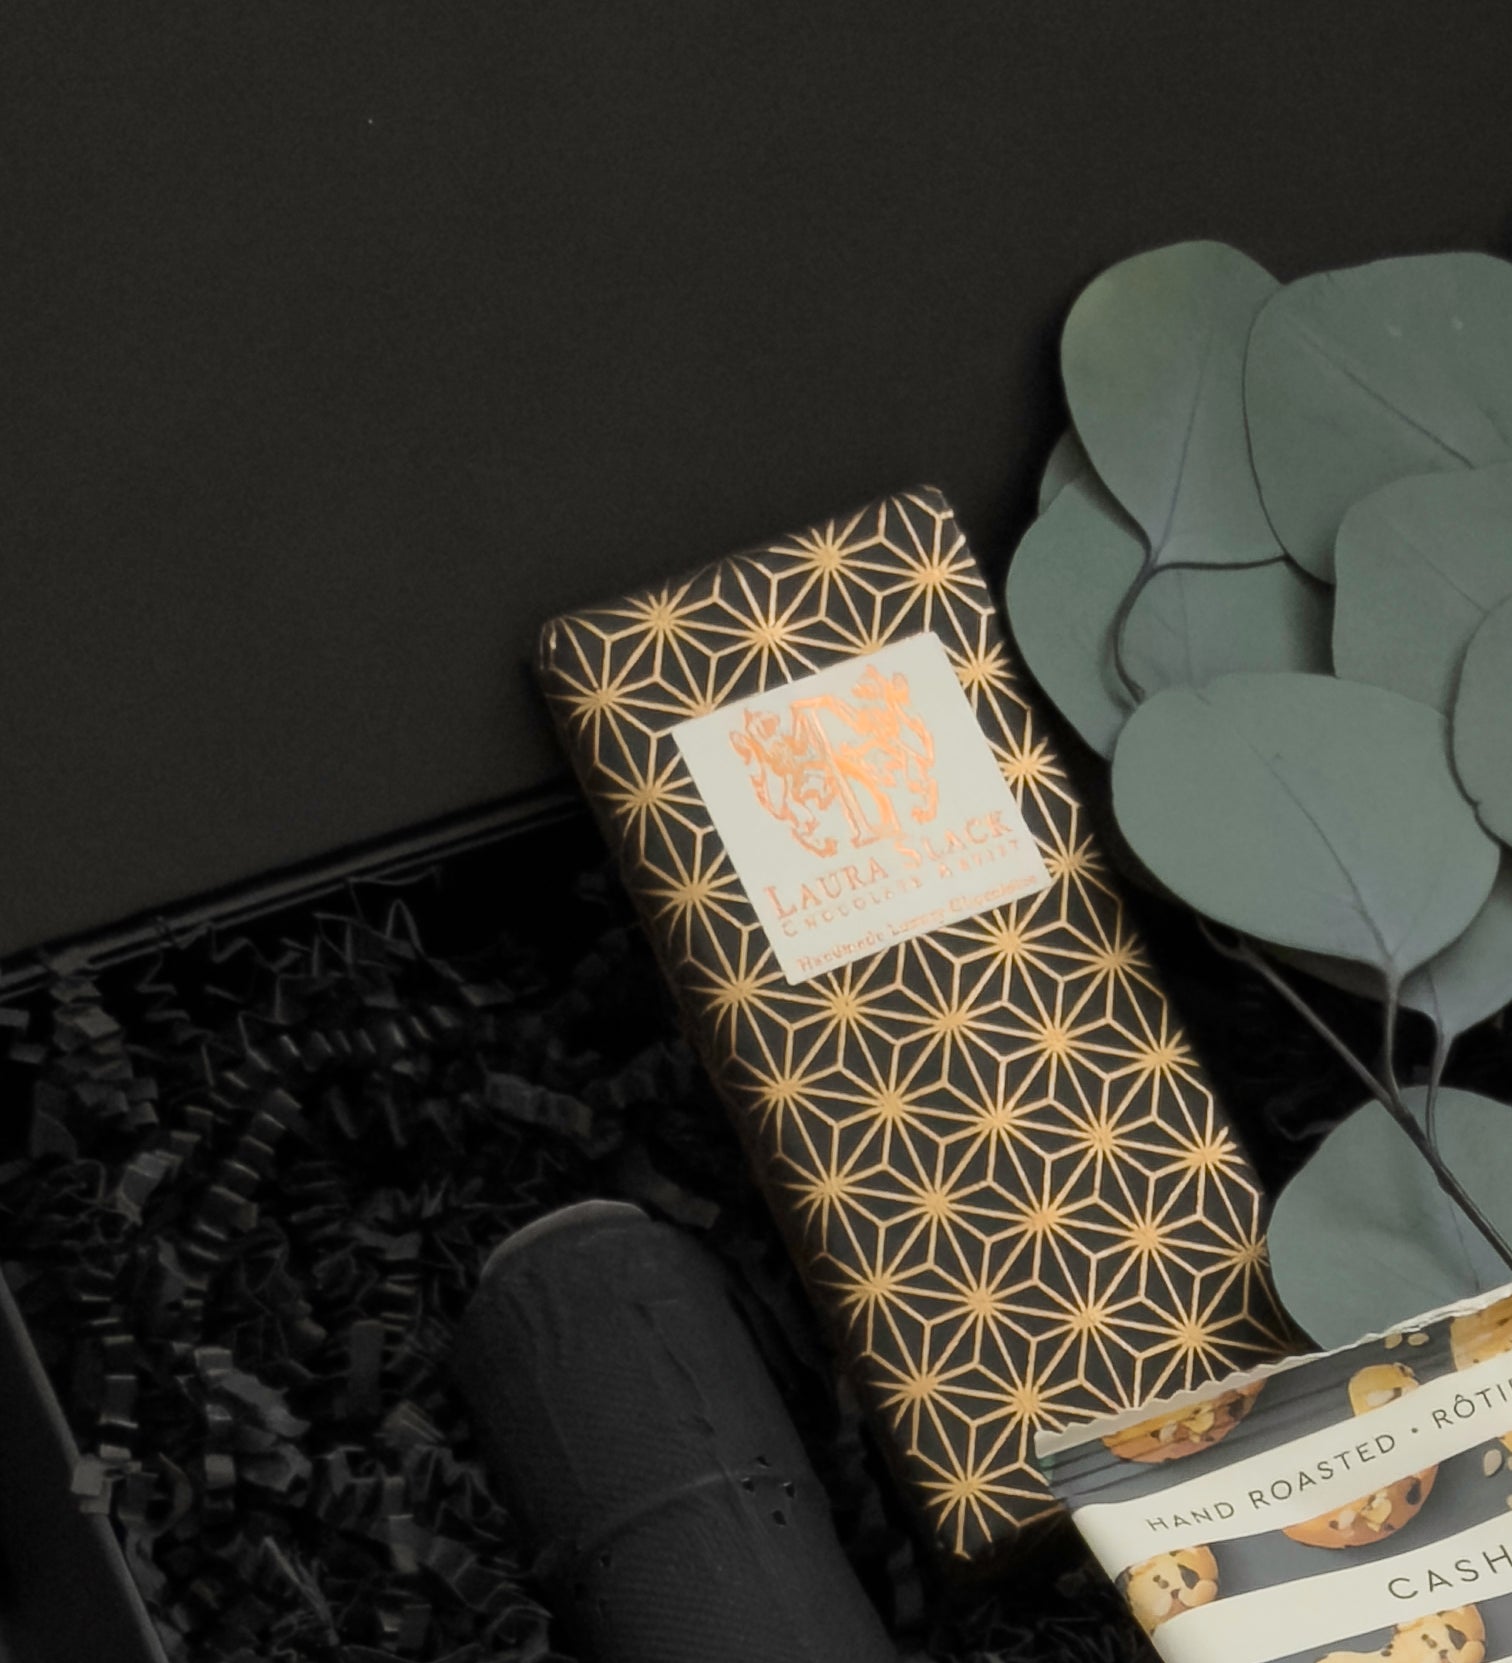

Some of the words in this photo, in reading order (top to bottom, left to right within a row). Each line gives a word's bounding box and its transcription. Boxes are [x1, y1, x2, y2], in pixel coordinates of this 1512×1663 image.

[764, 857, 889, 920] LAURA
[1145, 1501, 1236, 1532] HAND
[1248, 1433, 1396, 1510] ROASTED
